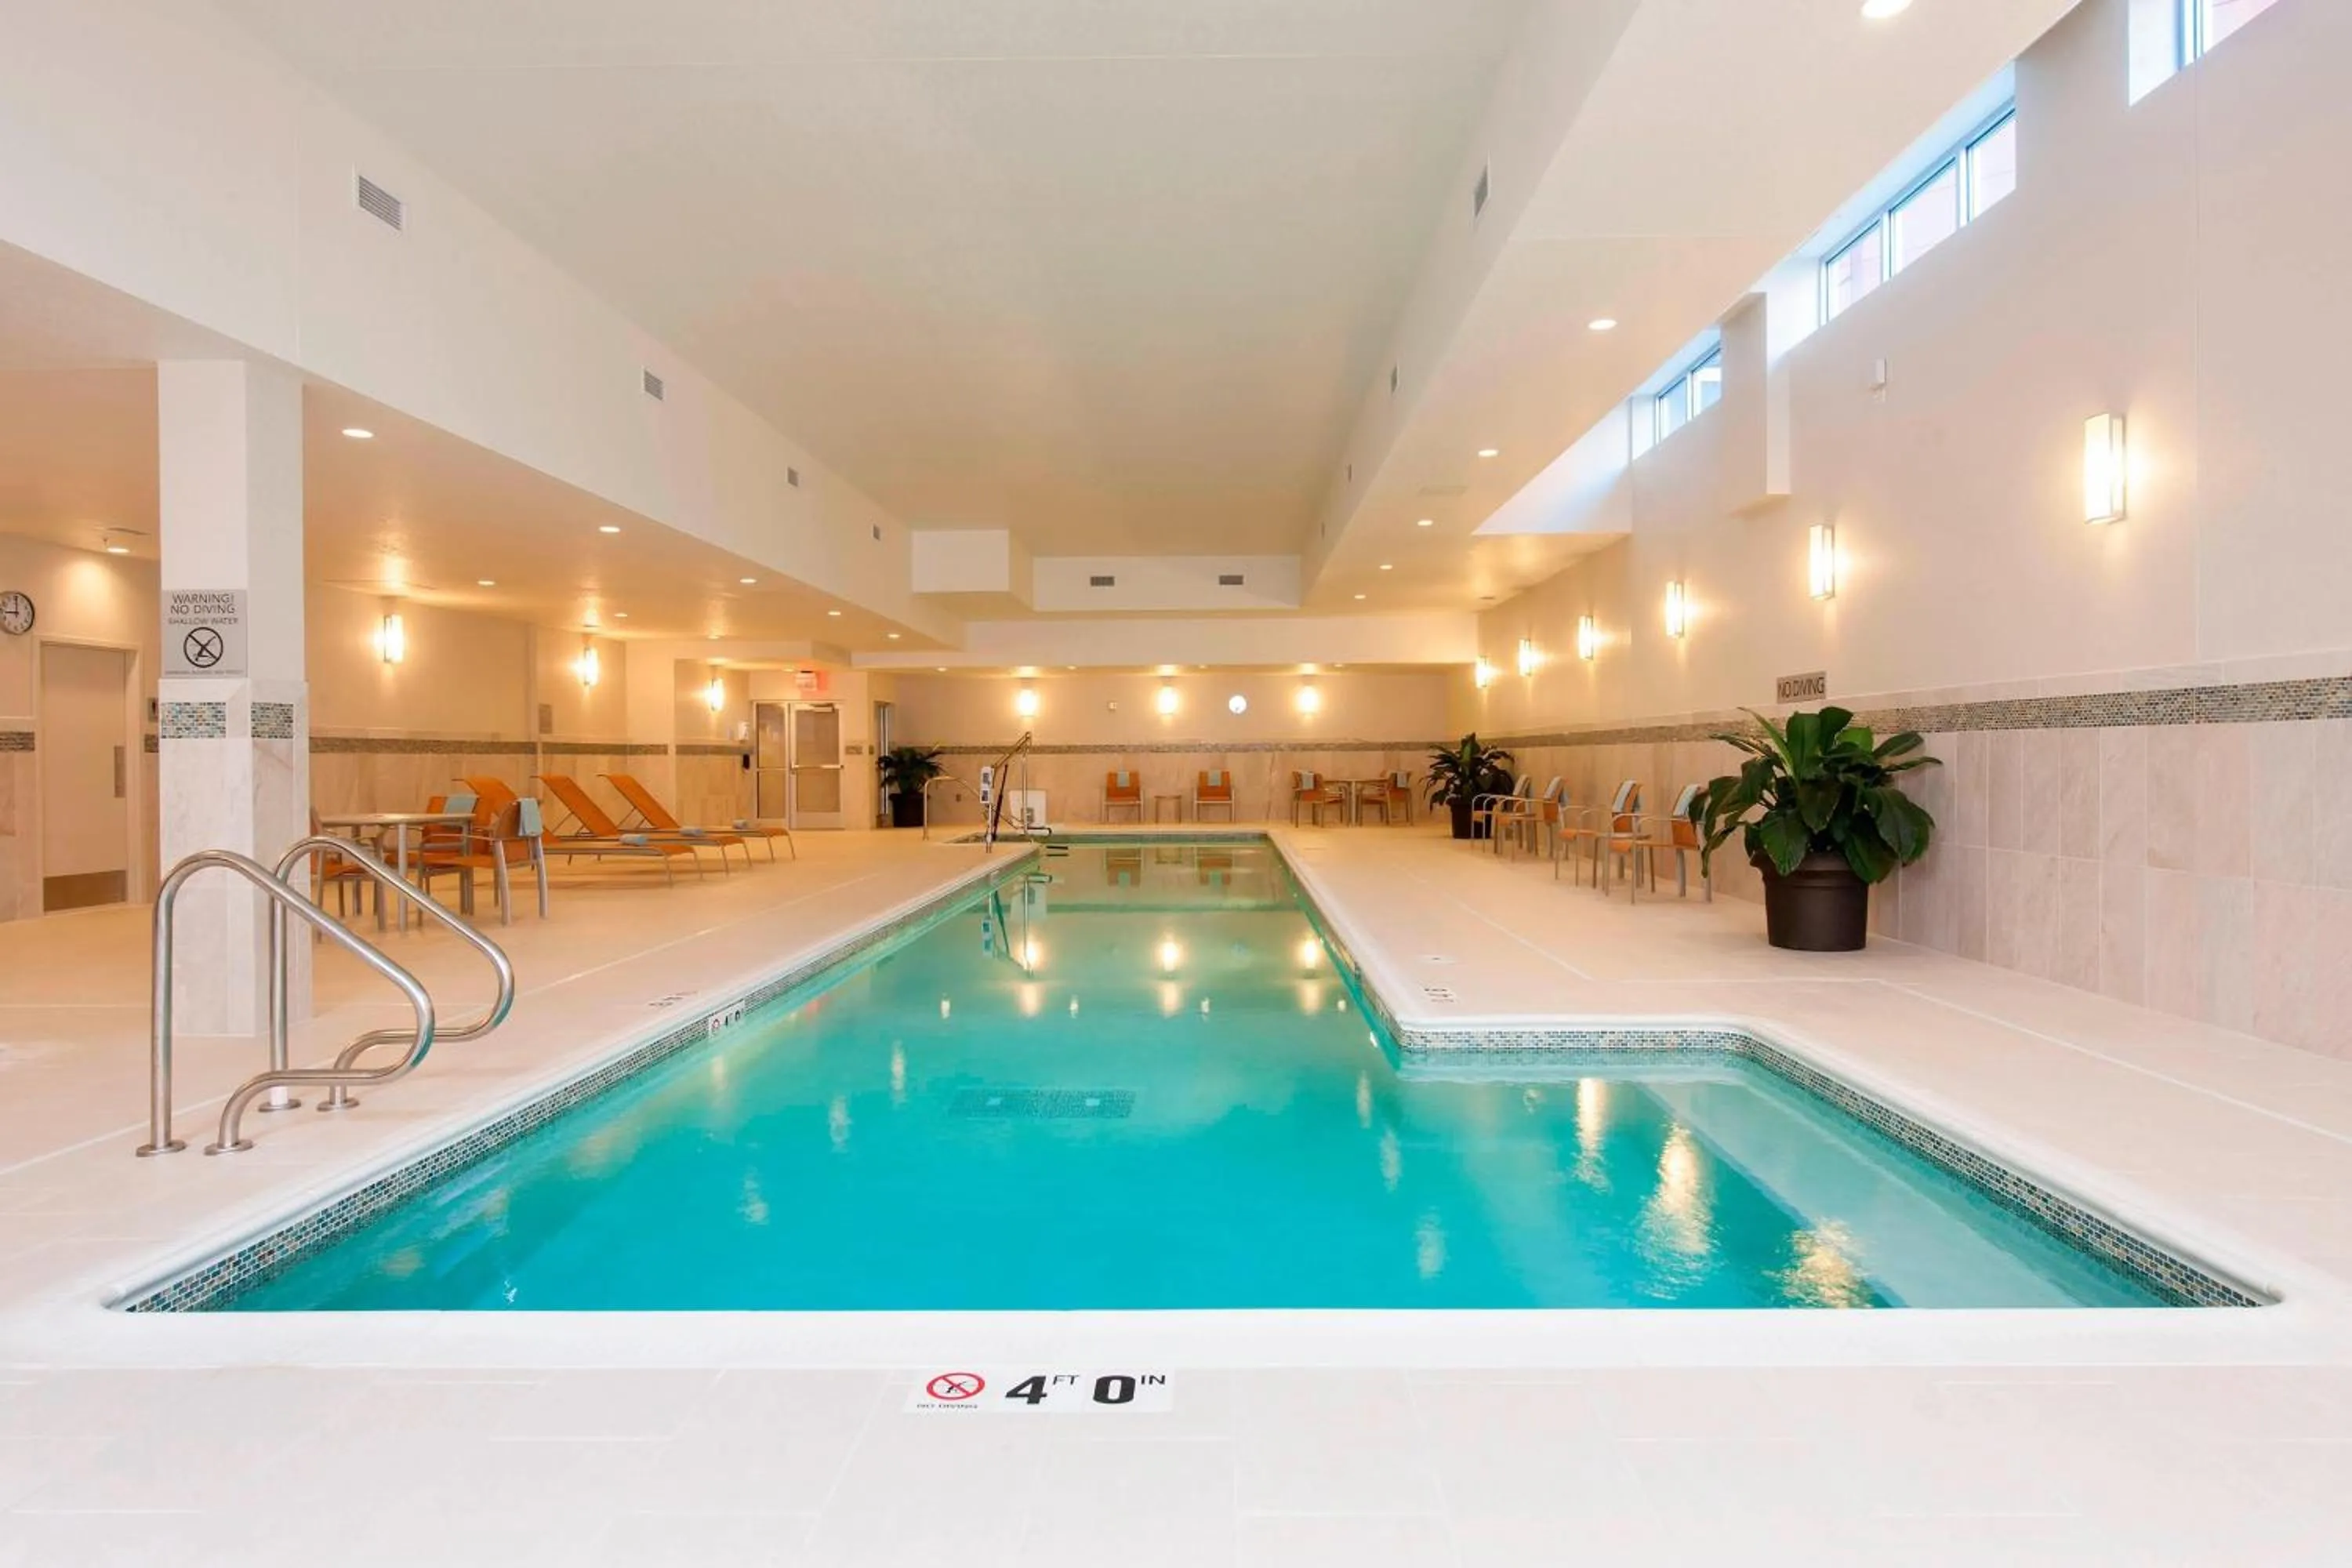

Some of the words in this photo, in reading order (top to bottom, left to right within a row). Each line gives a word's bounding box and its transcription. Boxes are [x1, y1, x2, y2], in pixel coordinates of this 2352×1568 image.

[172, 593, 234, 604] WARNING!
[170, 604, 190, 614] NO
[194, 604, 236, 614] DIVING
[1777, 681, 1791, 699] NO
[1793, 676, 1825, 697] DIVING
[1005, 1375, 1047, 1404] 4
[1052, 1374, 1080, 1385] FT
[1093, 1375, 1136, 1404] 0
[1141, 1374, 1166, 1385] IN
